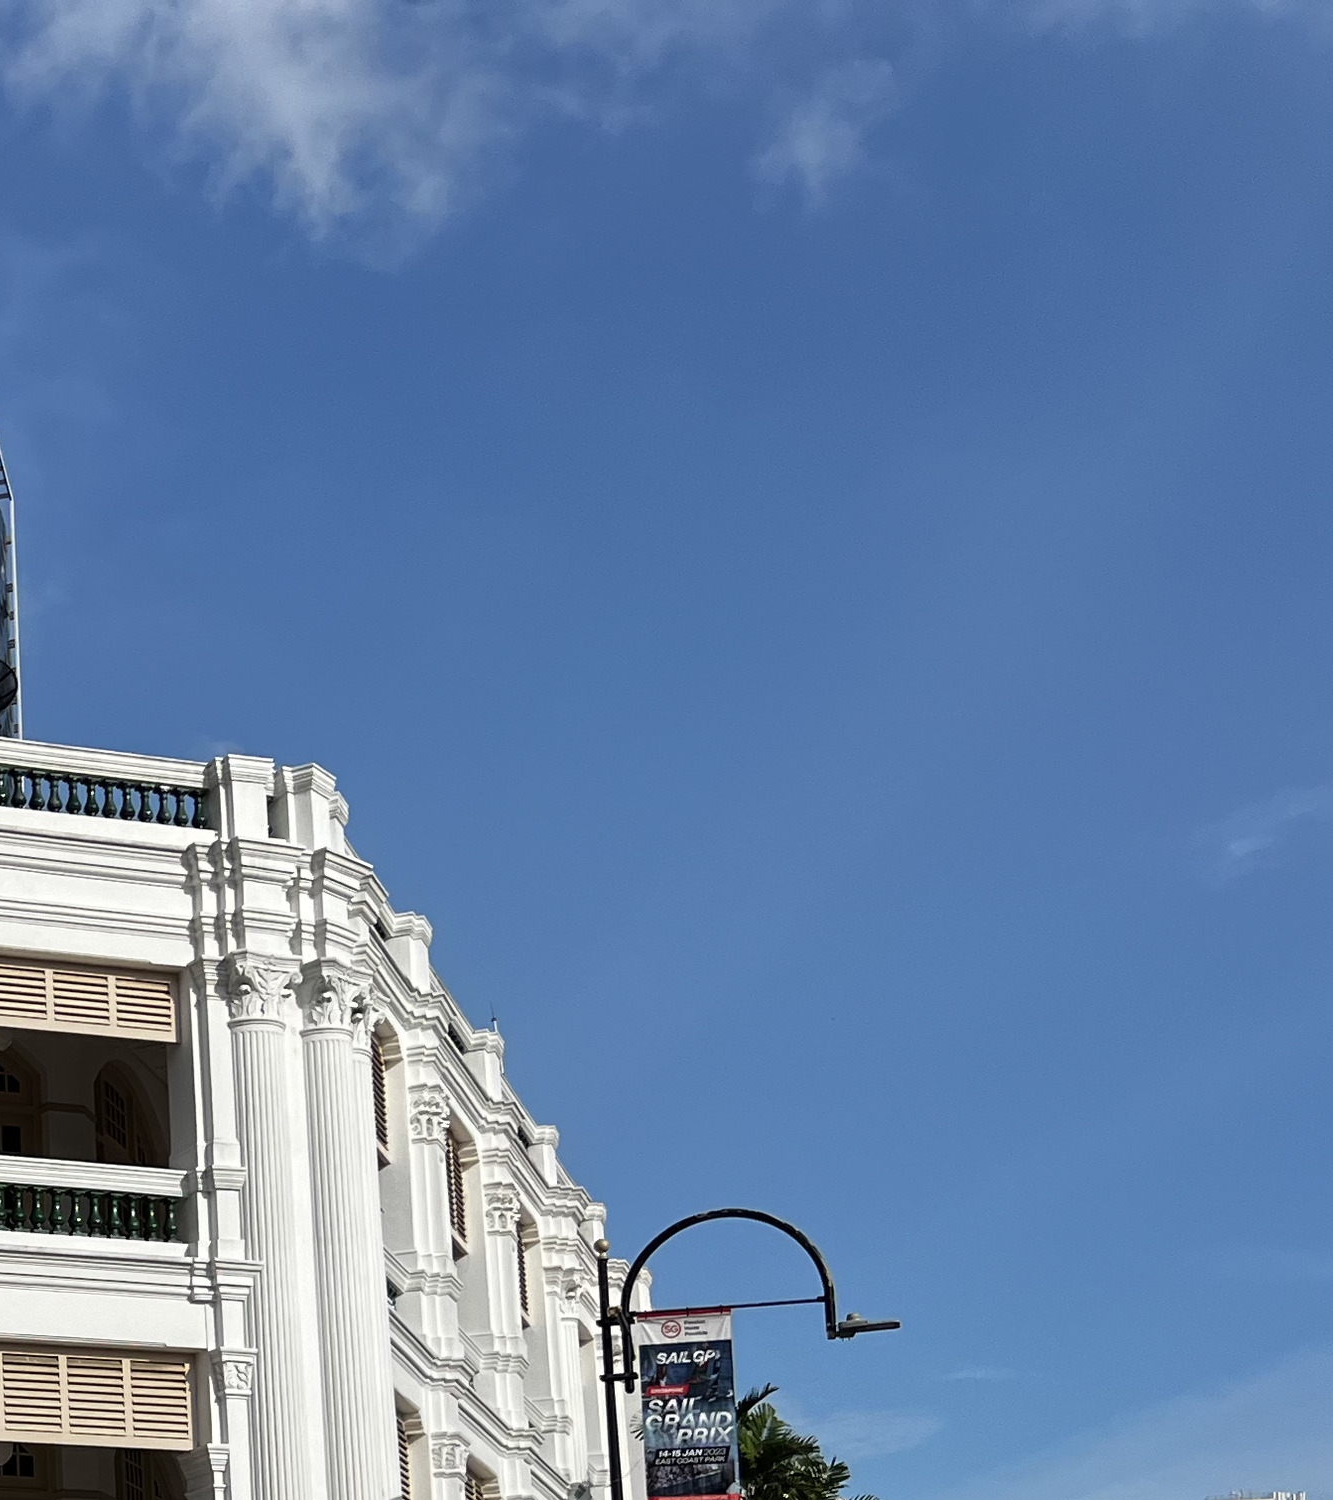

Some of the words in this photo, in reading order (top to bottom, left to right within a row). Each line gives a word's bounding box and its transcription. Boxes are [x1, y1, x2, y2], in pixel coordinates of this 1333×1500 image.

[645, 1411, 733, 1432] GRAND
[676, 1426, 734, 1445] PRIX
[682, 1448, 703, 1456] JAN
[676, 1457, 703, 1465] COAST
